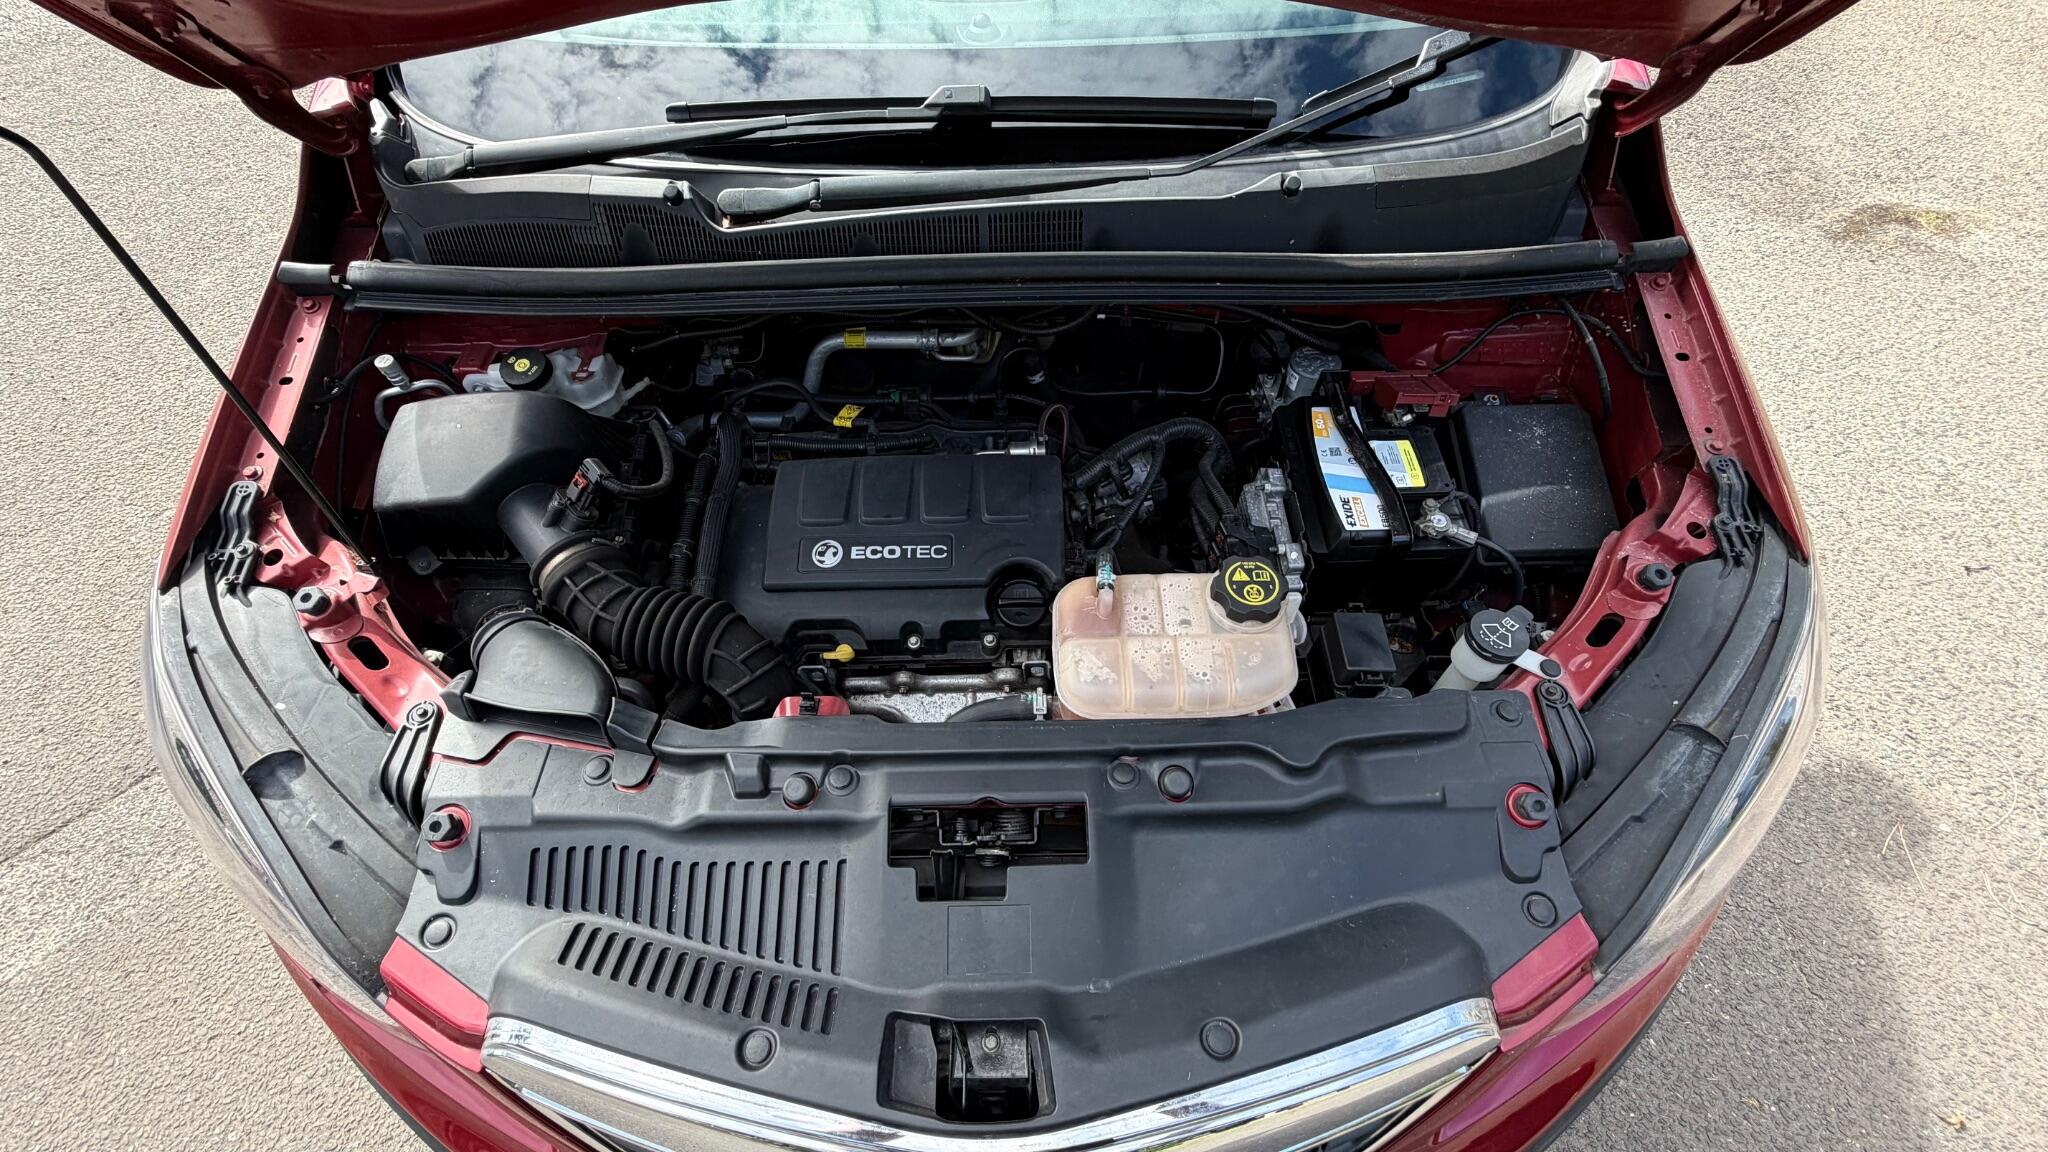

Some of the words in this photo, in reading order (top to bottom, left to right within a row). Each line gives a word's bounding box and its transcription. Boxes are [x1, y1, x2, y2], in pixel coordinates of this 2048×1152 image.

[1340, 496, 1357, 528] EXIDE
[1353, 497, 1369, 527] EXCELL
[851, 545, 948, 559] ECOTEC
